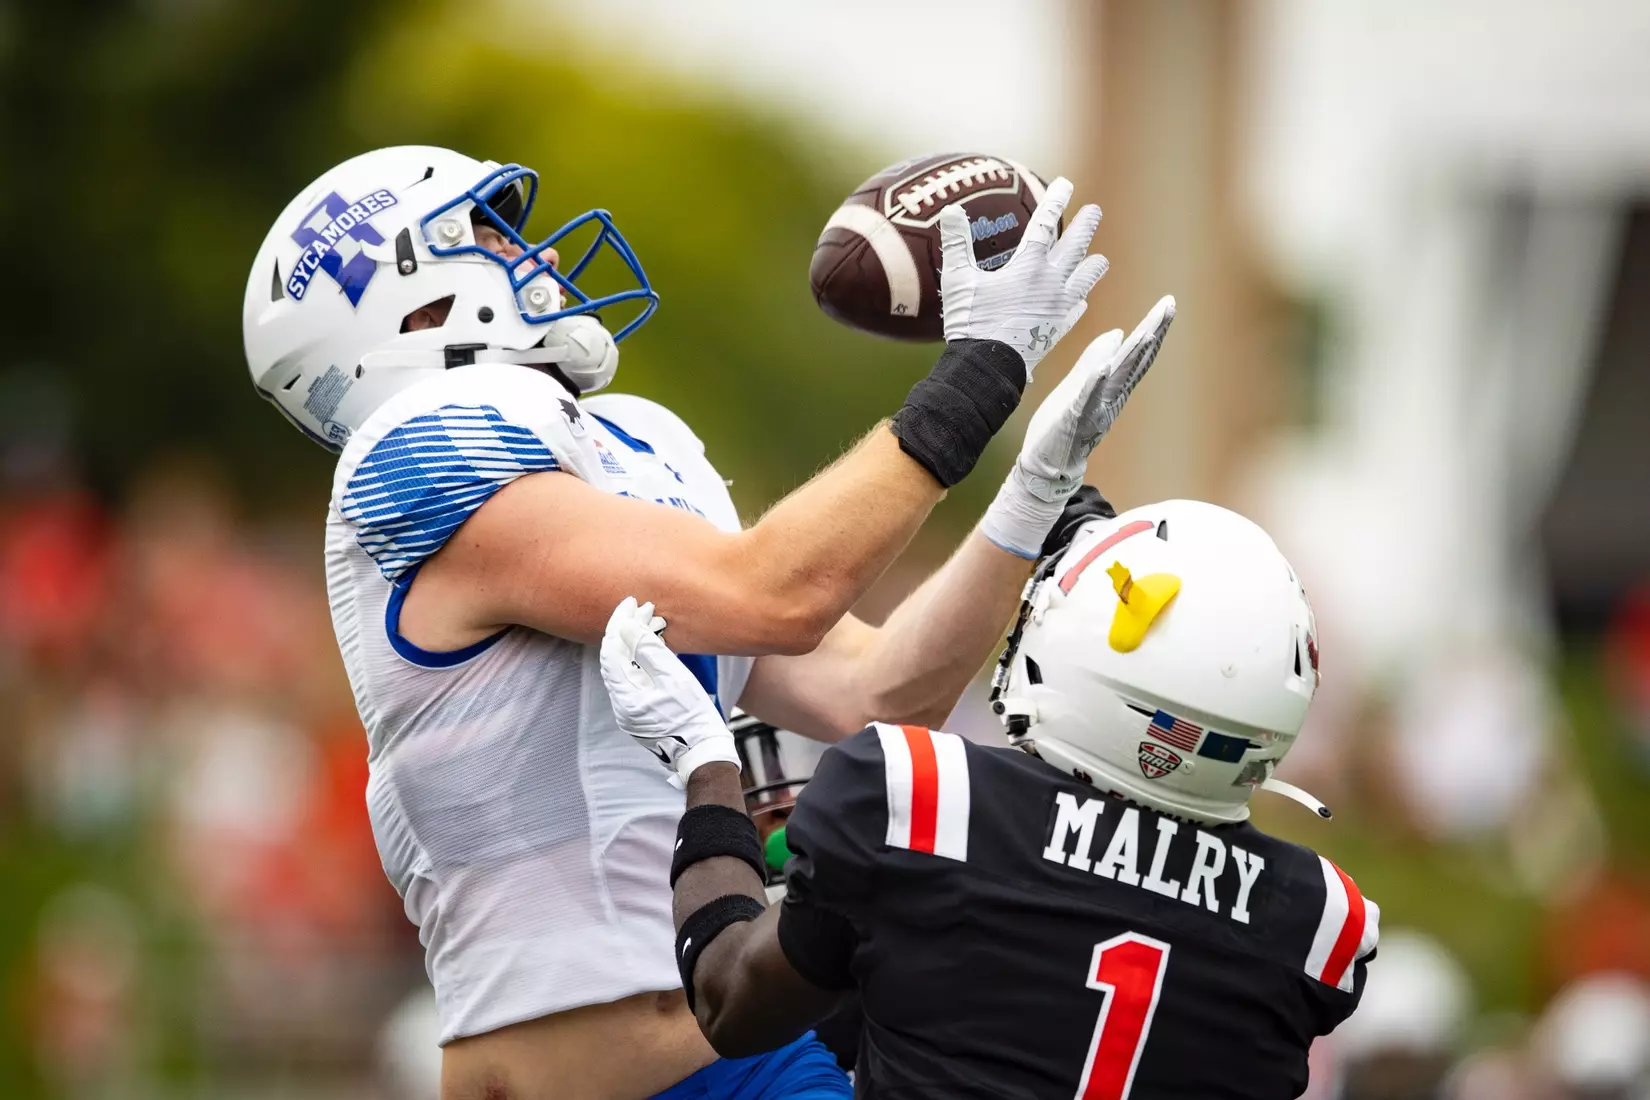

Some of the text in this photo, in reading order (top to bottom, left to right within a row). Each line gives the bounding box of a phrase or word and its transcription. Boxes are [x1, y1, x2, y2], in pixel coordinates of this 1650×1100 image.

[288, 190, 396, 298] SYCAMORES
[971, 212, 1019, 243] ilson
[1139, 751, 1178, 771] MAC
[1043, 791, 1265, 925] MALRY
[1076, 931, 1171, 1100] 1
